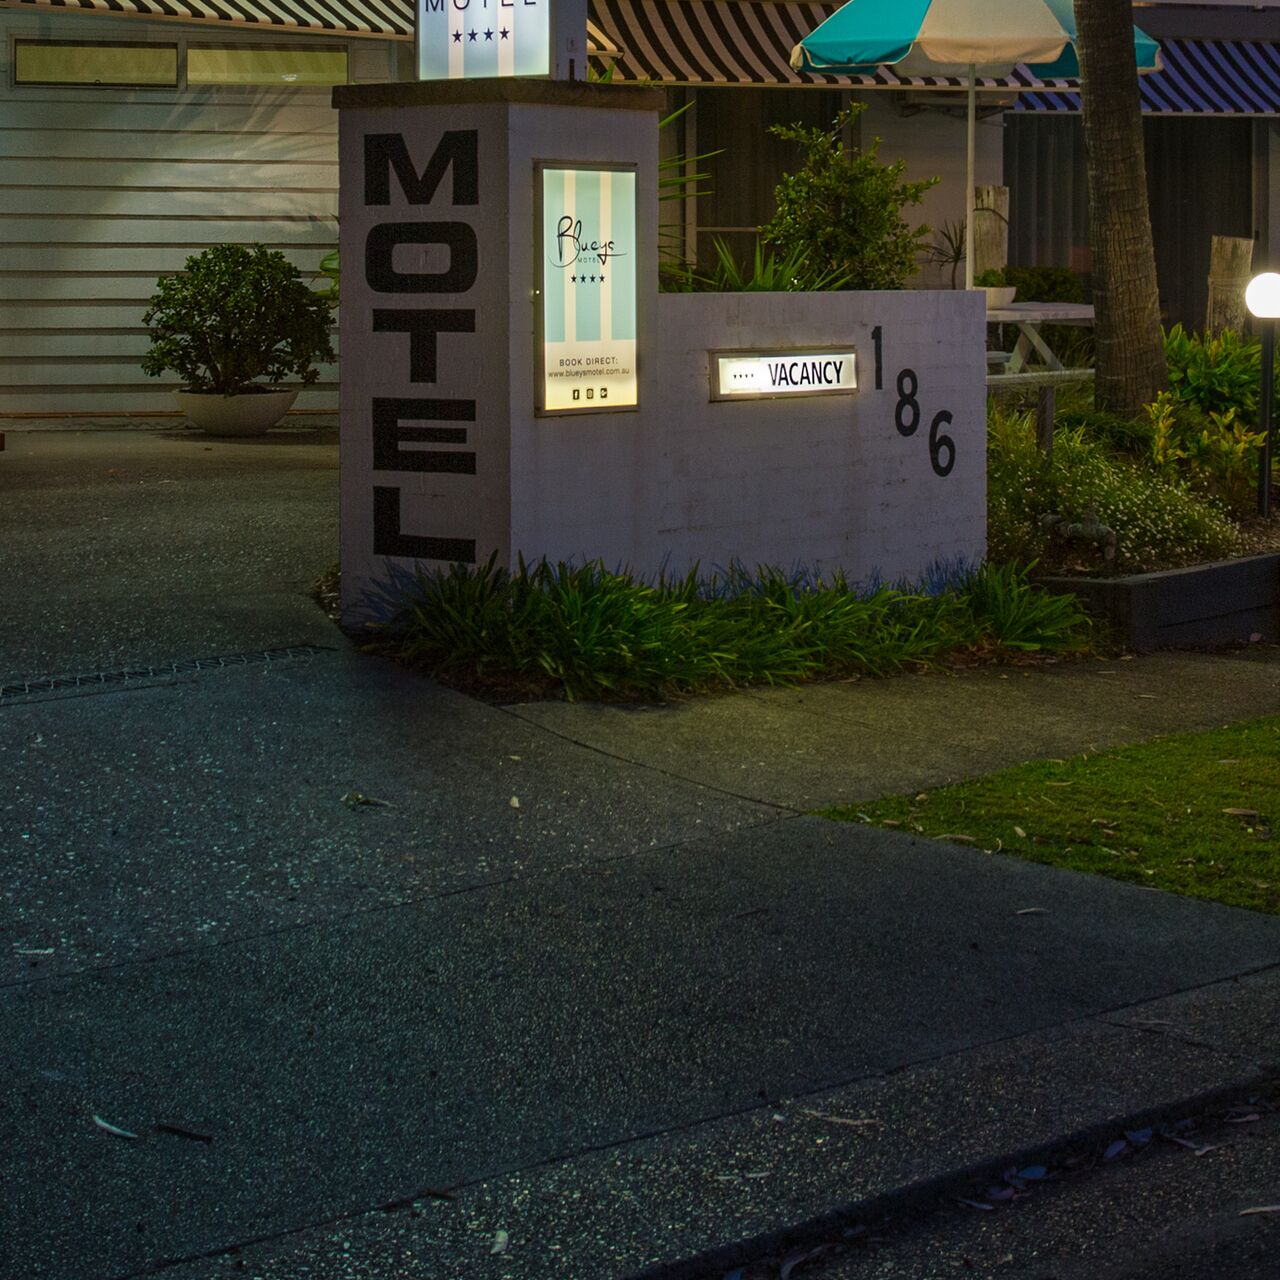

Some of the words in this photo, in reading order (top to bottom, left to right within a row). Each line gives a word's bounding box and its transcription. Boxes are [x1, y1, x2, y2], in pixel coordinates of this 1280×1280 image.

[548, 216, 628, 268] Blueys
[364, 129, 480, 564] MOTEL
[548, 367, 630, 379] www.blueysmotel.com.au
[559, 358, 582, 367] BOOK
[585, 356, 618, 366] DIRECT:
[769, 360, 844, 387] VACANCY
